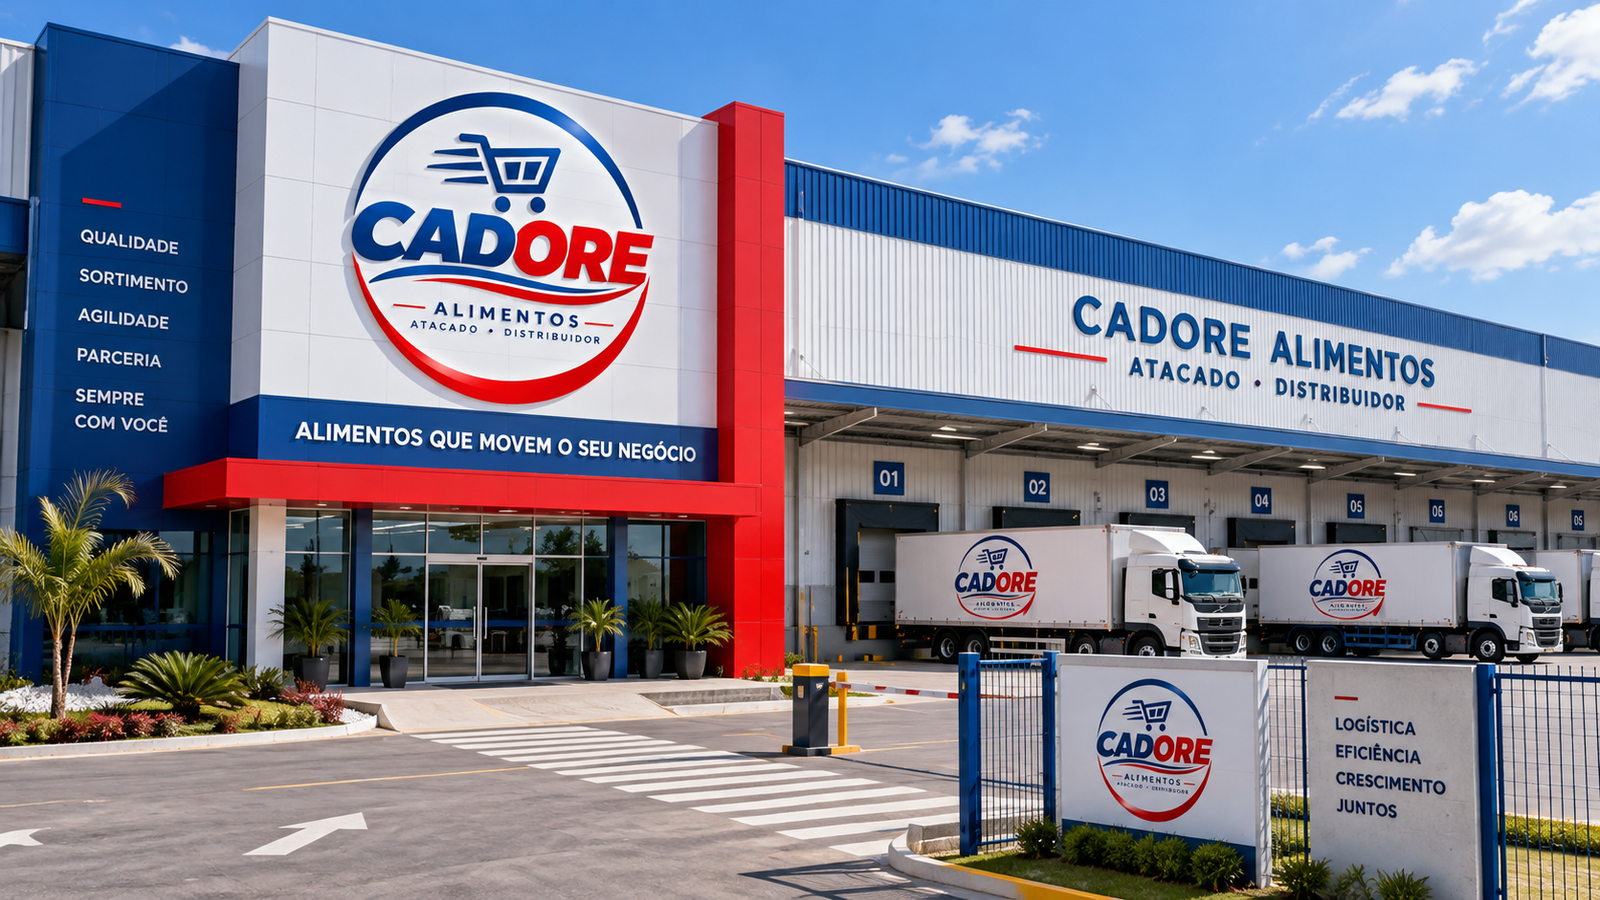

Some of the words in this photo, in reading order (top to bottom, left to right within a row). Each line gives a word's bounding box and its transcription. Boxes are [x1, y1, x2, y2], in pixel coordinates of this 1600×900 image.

[80, 229, 179, 255] QUALIDADE
[351, 200, 655, 285] CADORE
[79, 268, 189, 294] SORTIMENTO
[77, 307, 169, 330] AGILIDADE
[433, 301, 580, 329] ALIMENTOS
[410, 319, 478, 335] ATACADO
[504, 327, 601, 345] DISTRIBUIDOR
[1073, 294, 1251, 360] CADORE
[1271, 330, 1435, 388] ALIMENTOS
[77, 347, 162, 368] PARCERIA
[1129, 356, 1241, 390] ATACADO
[1276, 377, 1406, 411] DISTRIBUIDOR
[75, 388, 145, 407] SEMPRE
[74, 414, 115, 430] COM
[120, 415, 168, 433] VOCÊ
[294, 421, 423, 447] ALIMENTOS
[429, 429, 473, 450] QUE
[479, 432, 552, 454] MOVEM
[557, 438, 573, 456] O
[578, 439, 613, 458] SEU
[618, 440, 697, 463] NEGÓCIO
[879, 469, 898, 487] 01
[1028, 479, 1047, 495] 02
[1149, 486, 1166, 502] 03
[1254, 493, 1269, 508] 04
[1350, 499, 1363, 513] 05
[1432, 505, 1444, 518] 06
[954, 571, 1039, 593] CADORE
[1309, 579, 1387, 597] CADORE
[1335, 715, 1416, 736] LOGÍSTICA
[1096, 730, 1214, 765] CADORE
[1335, 742, 1422, 765] EFICIÊNCIA
[1124, 773, 1181, 787] ALIMENTOS
[1335, 771, 1446, 796] CRESCIMENTO
[1336, 798, 1398, 819] JUNTOS
